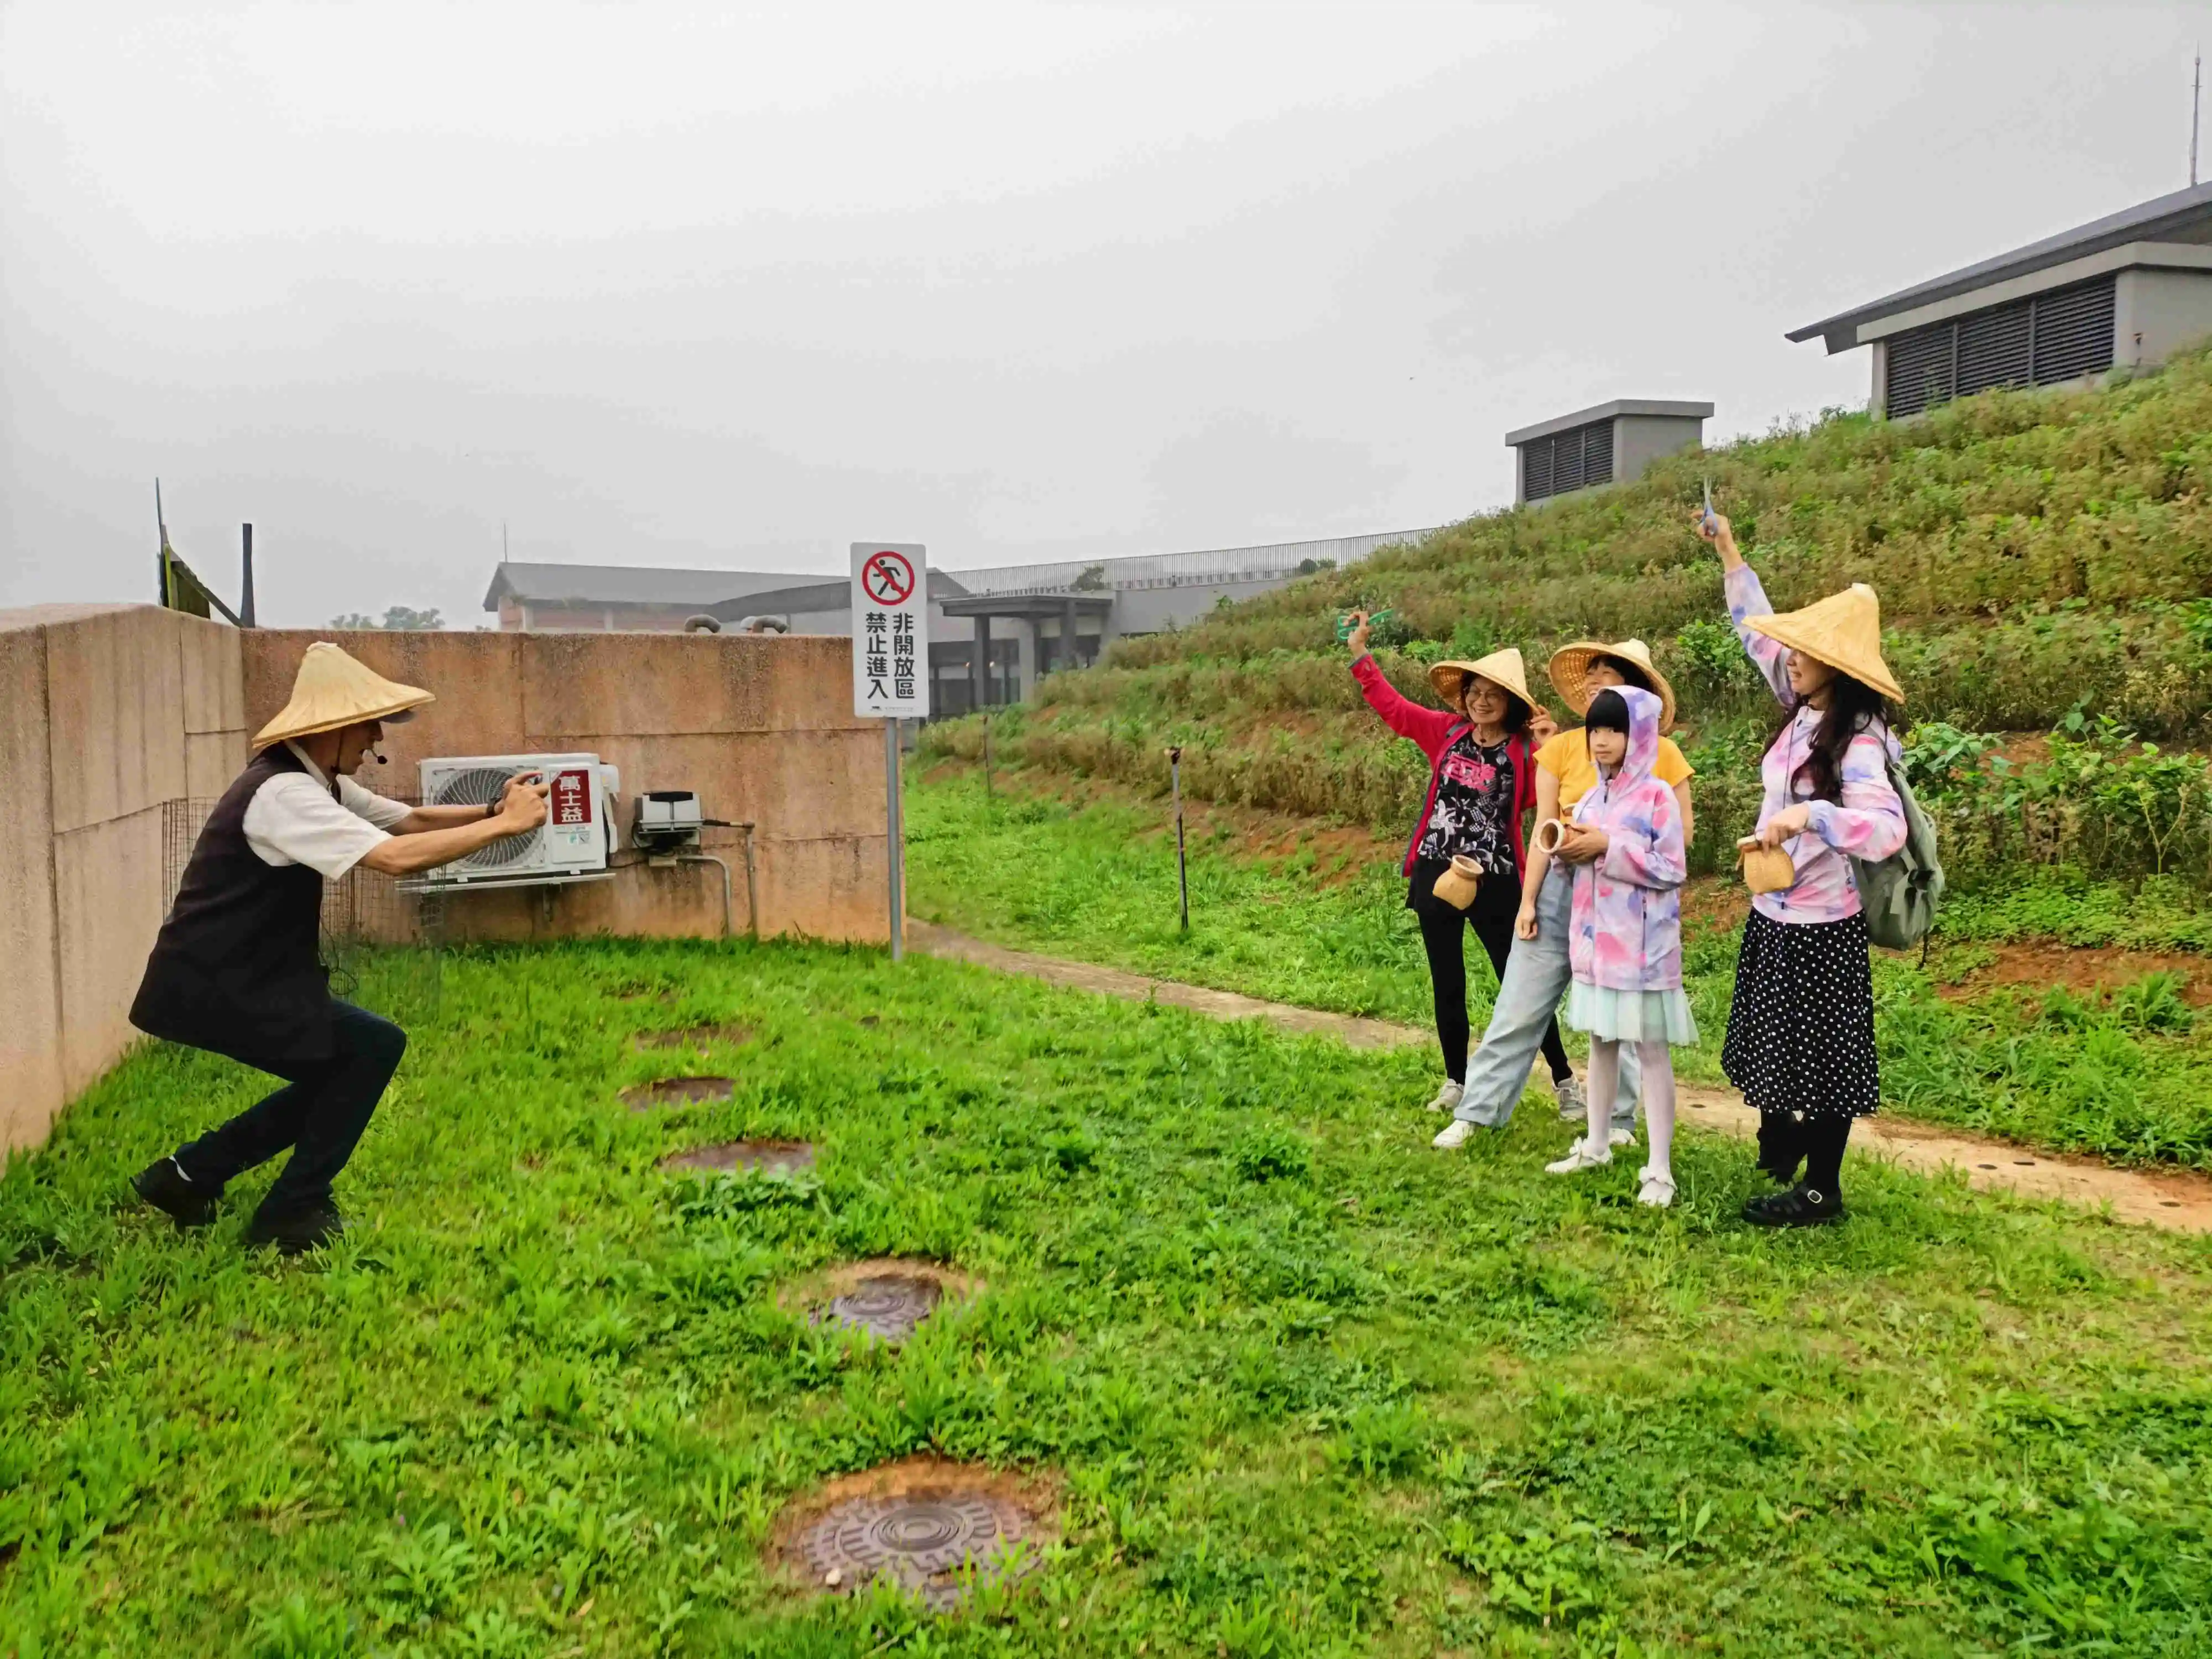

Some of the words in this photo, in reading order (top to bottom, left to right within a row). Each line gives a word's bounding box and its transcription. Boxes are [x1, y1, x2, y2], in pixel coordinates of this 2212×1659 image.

[866, 612, 889, 699] 禁止進入
[893, 613, 915, 699] 非開放區
[559, 775, 583, 822] 萬士益
